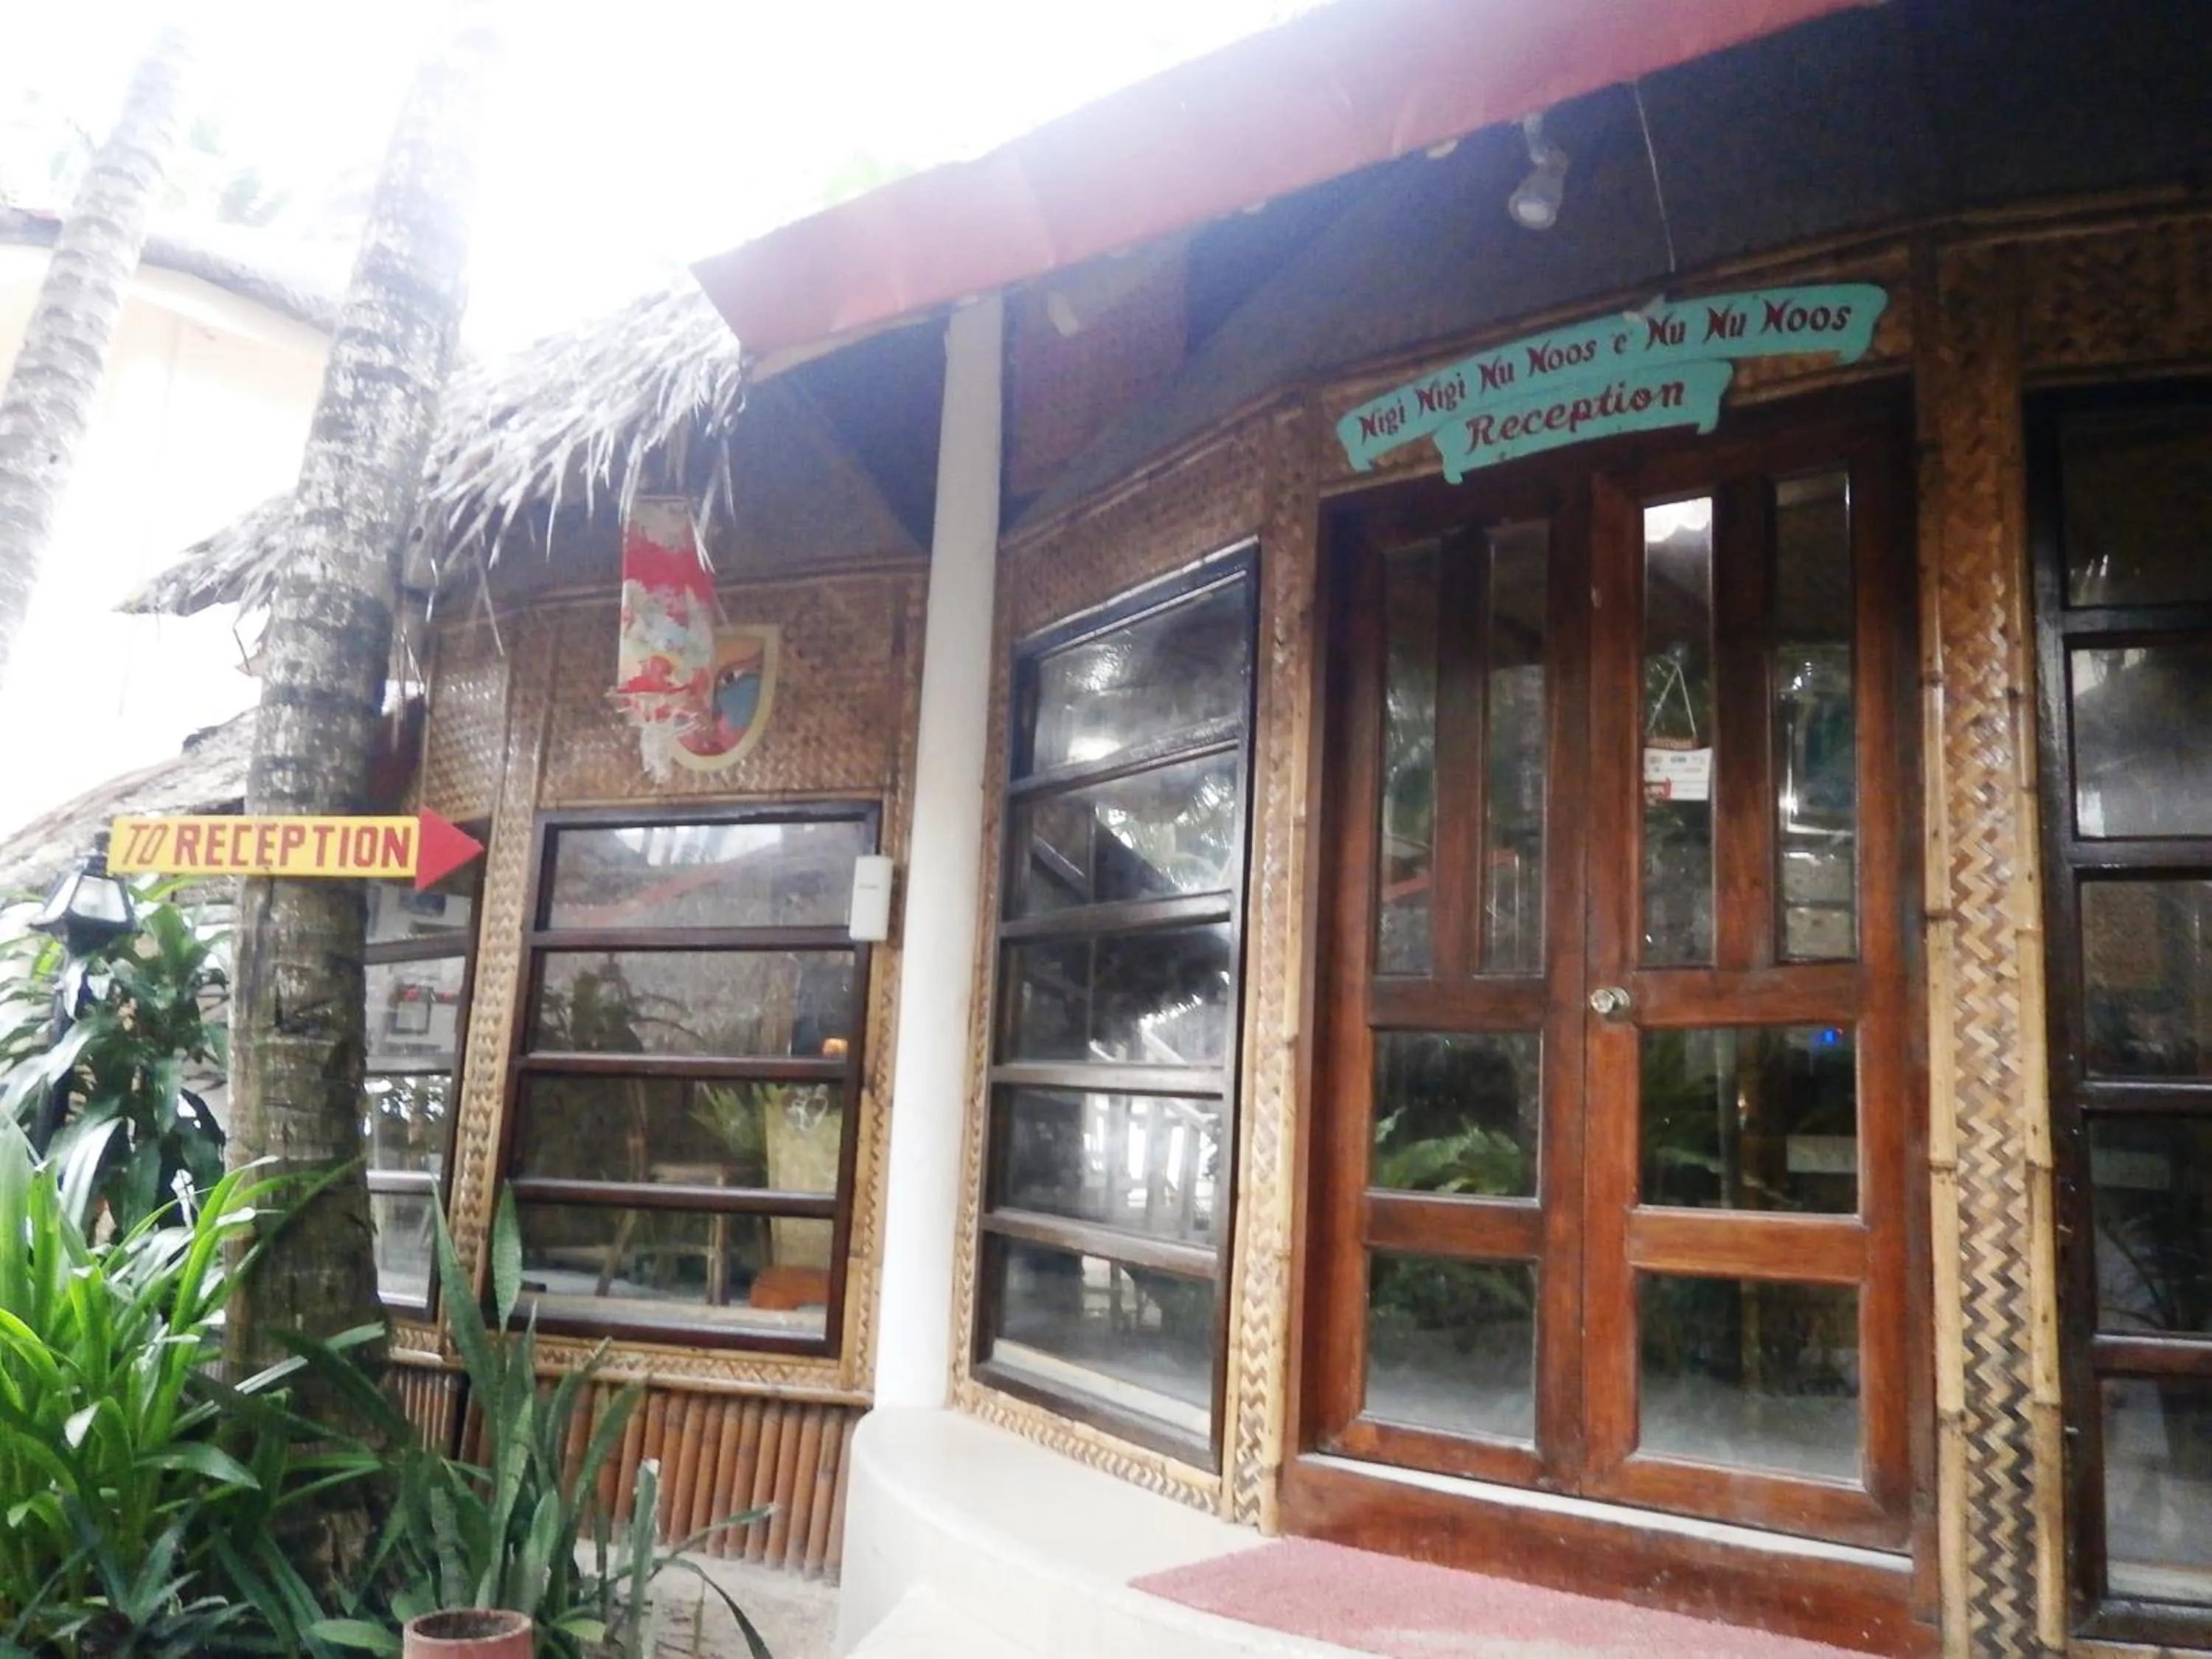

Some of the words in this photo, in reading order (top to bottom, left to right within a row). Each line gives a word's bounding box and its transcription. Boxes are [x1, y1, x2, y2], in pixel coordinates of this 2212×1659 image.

[1357, 397, 1406, 446] Nigi
[1415, 372, 1466, 418] Nigi
[1476, 354, 1515, 397] Nu
[1526, 339, 1598, 378] Noos
[1645, 311, 1686, 351] Nu
[1702, 302, 1747, 344] Nu
[1759, 297, 1852, 334] Noos
[1465, 380, 1685, 455] Reception
[122, 823, 170, 866] TO
[173, 823, 411, 869] RECEPTION
